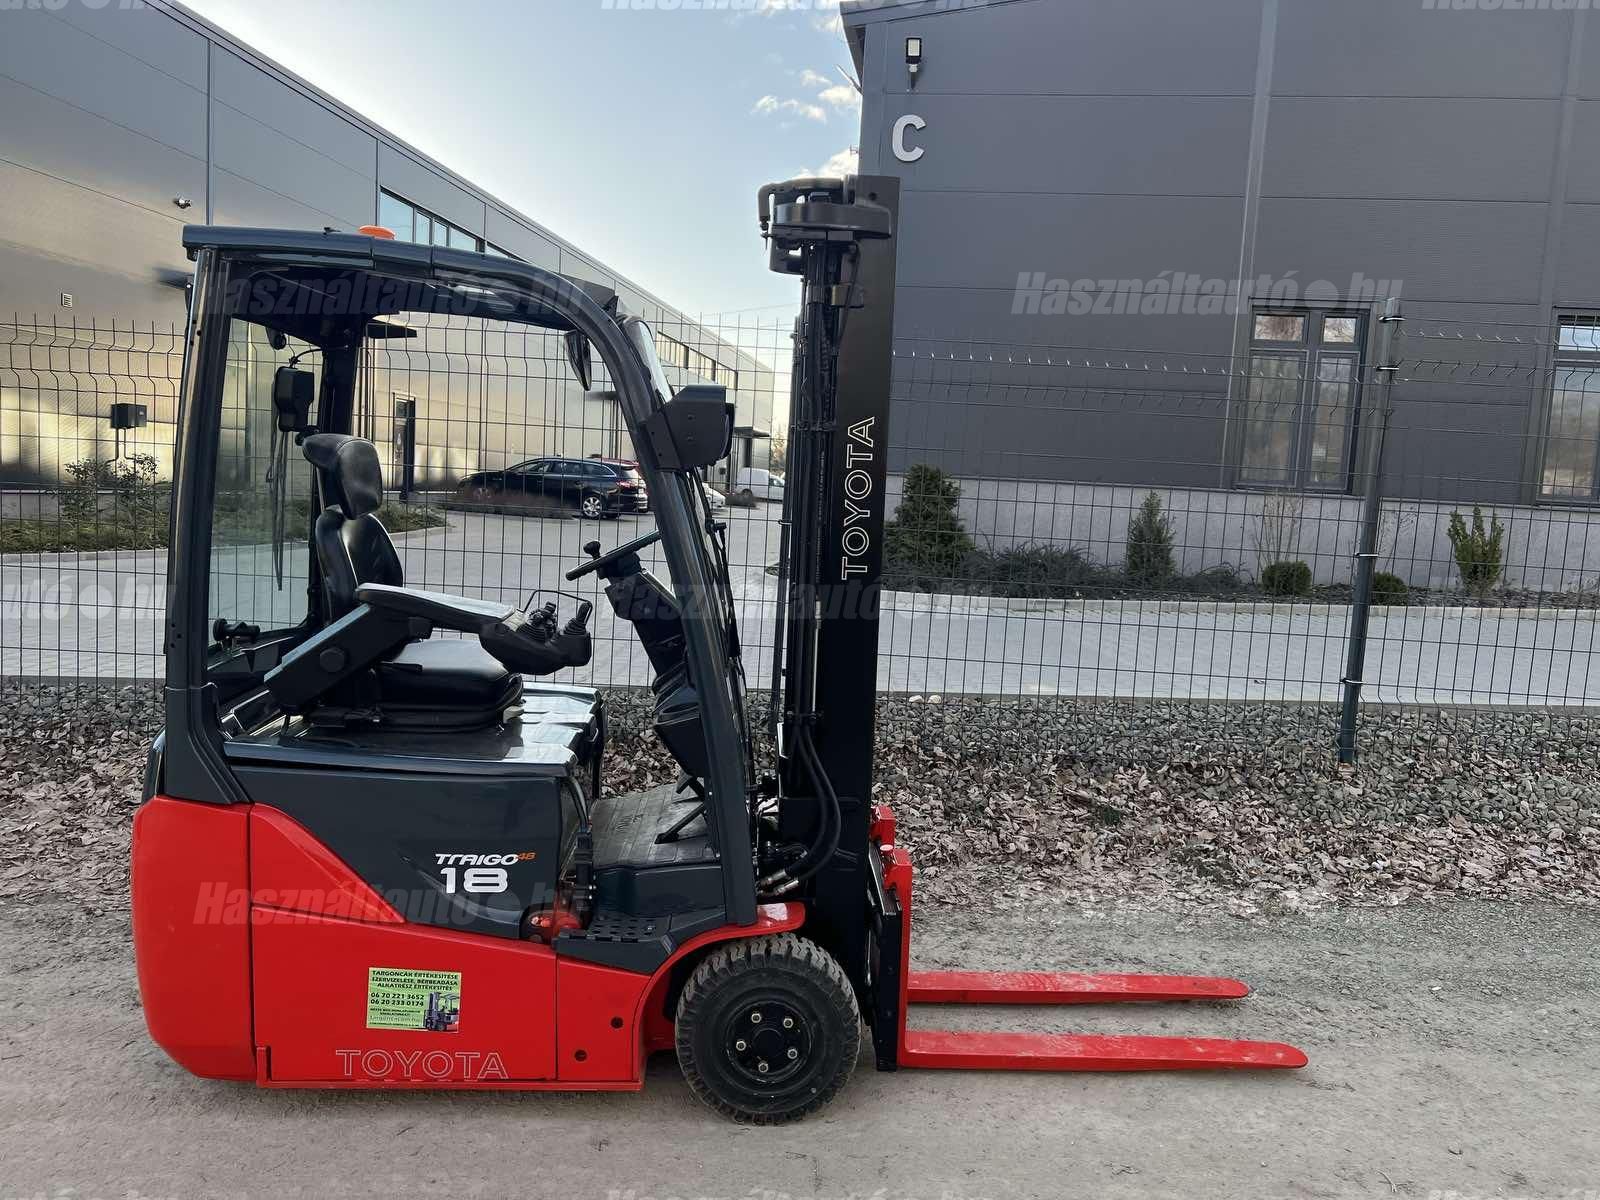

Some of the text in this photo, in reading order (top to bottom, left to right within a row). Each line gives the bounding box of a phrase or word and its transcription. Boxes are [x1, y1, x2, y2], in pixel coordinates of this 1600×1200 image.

[892, 114, 927, 162] C
[841, 416, 875, 581] TOYOTA
[435, 853, 519, 866] TRAIGO
[440, 867, 508, 894] 18
[335, 1049, 509, 1080] TOYOTA
